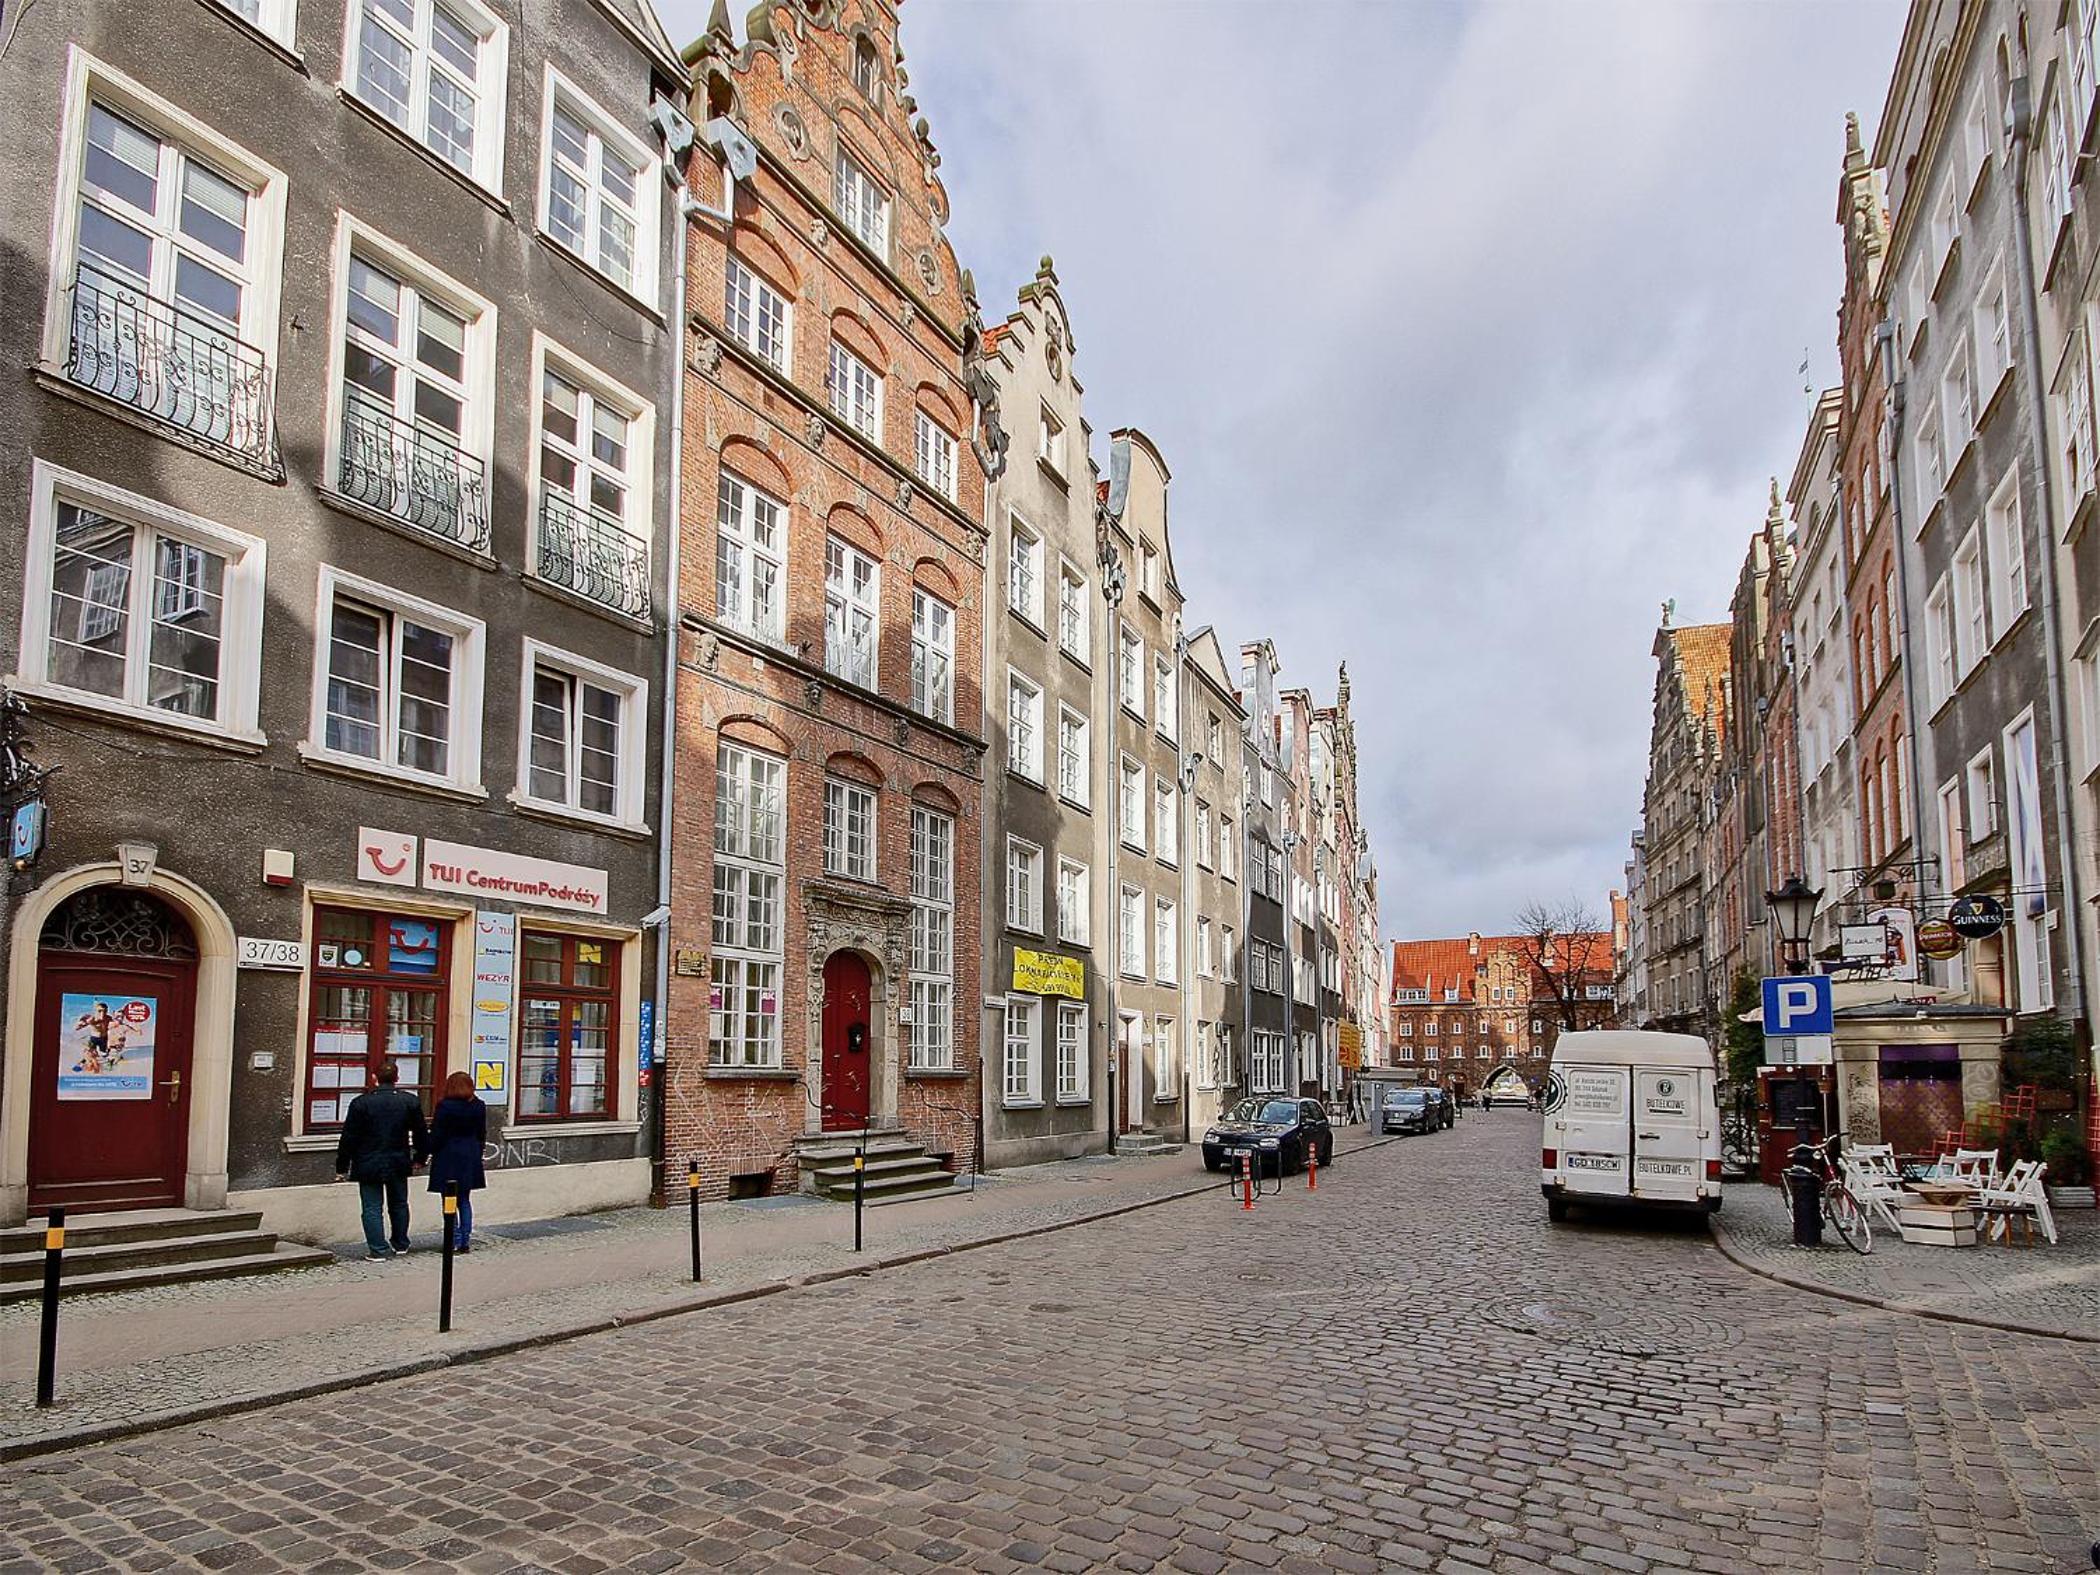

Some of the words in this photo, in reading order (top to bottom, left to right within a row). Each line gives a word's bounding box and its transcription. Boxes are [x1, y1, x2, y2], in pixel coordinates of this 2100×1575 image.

[128, 859, 149, 873] 37
[430, 863, 461, 884] TUI
[1953, 913, 2001, 925] GUINNESS
[499, 926, 513, 935] TUI
[246, 941, 299, 962] 37/38
[477, 973, 510, 983] WEZYR
[1777, 982, 1818, 1028] P
[1647, 1098, 1685, 1110] BUTELKOWE
[1575, 1157, 1588, 1168] GD
[1638, 1162, 1692, 1175] BUTELKOWE.PL
